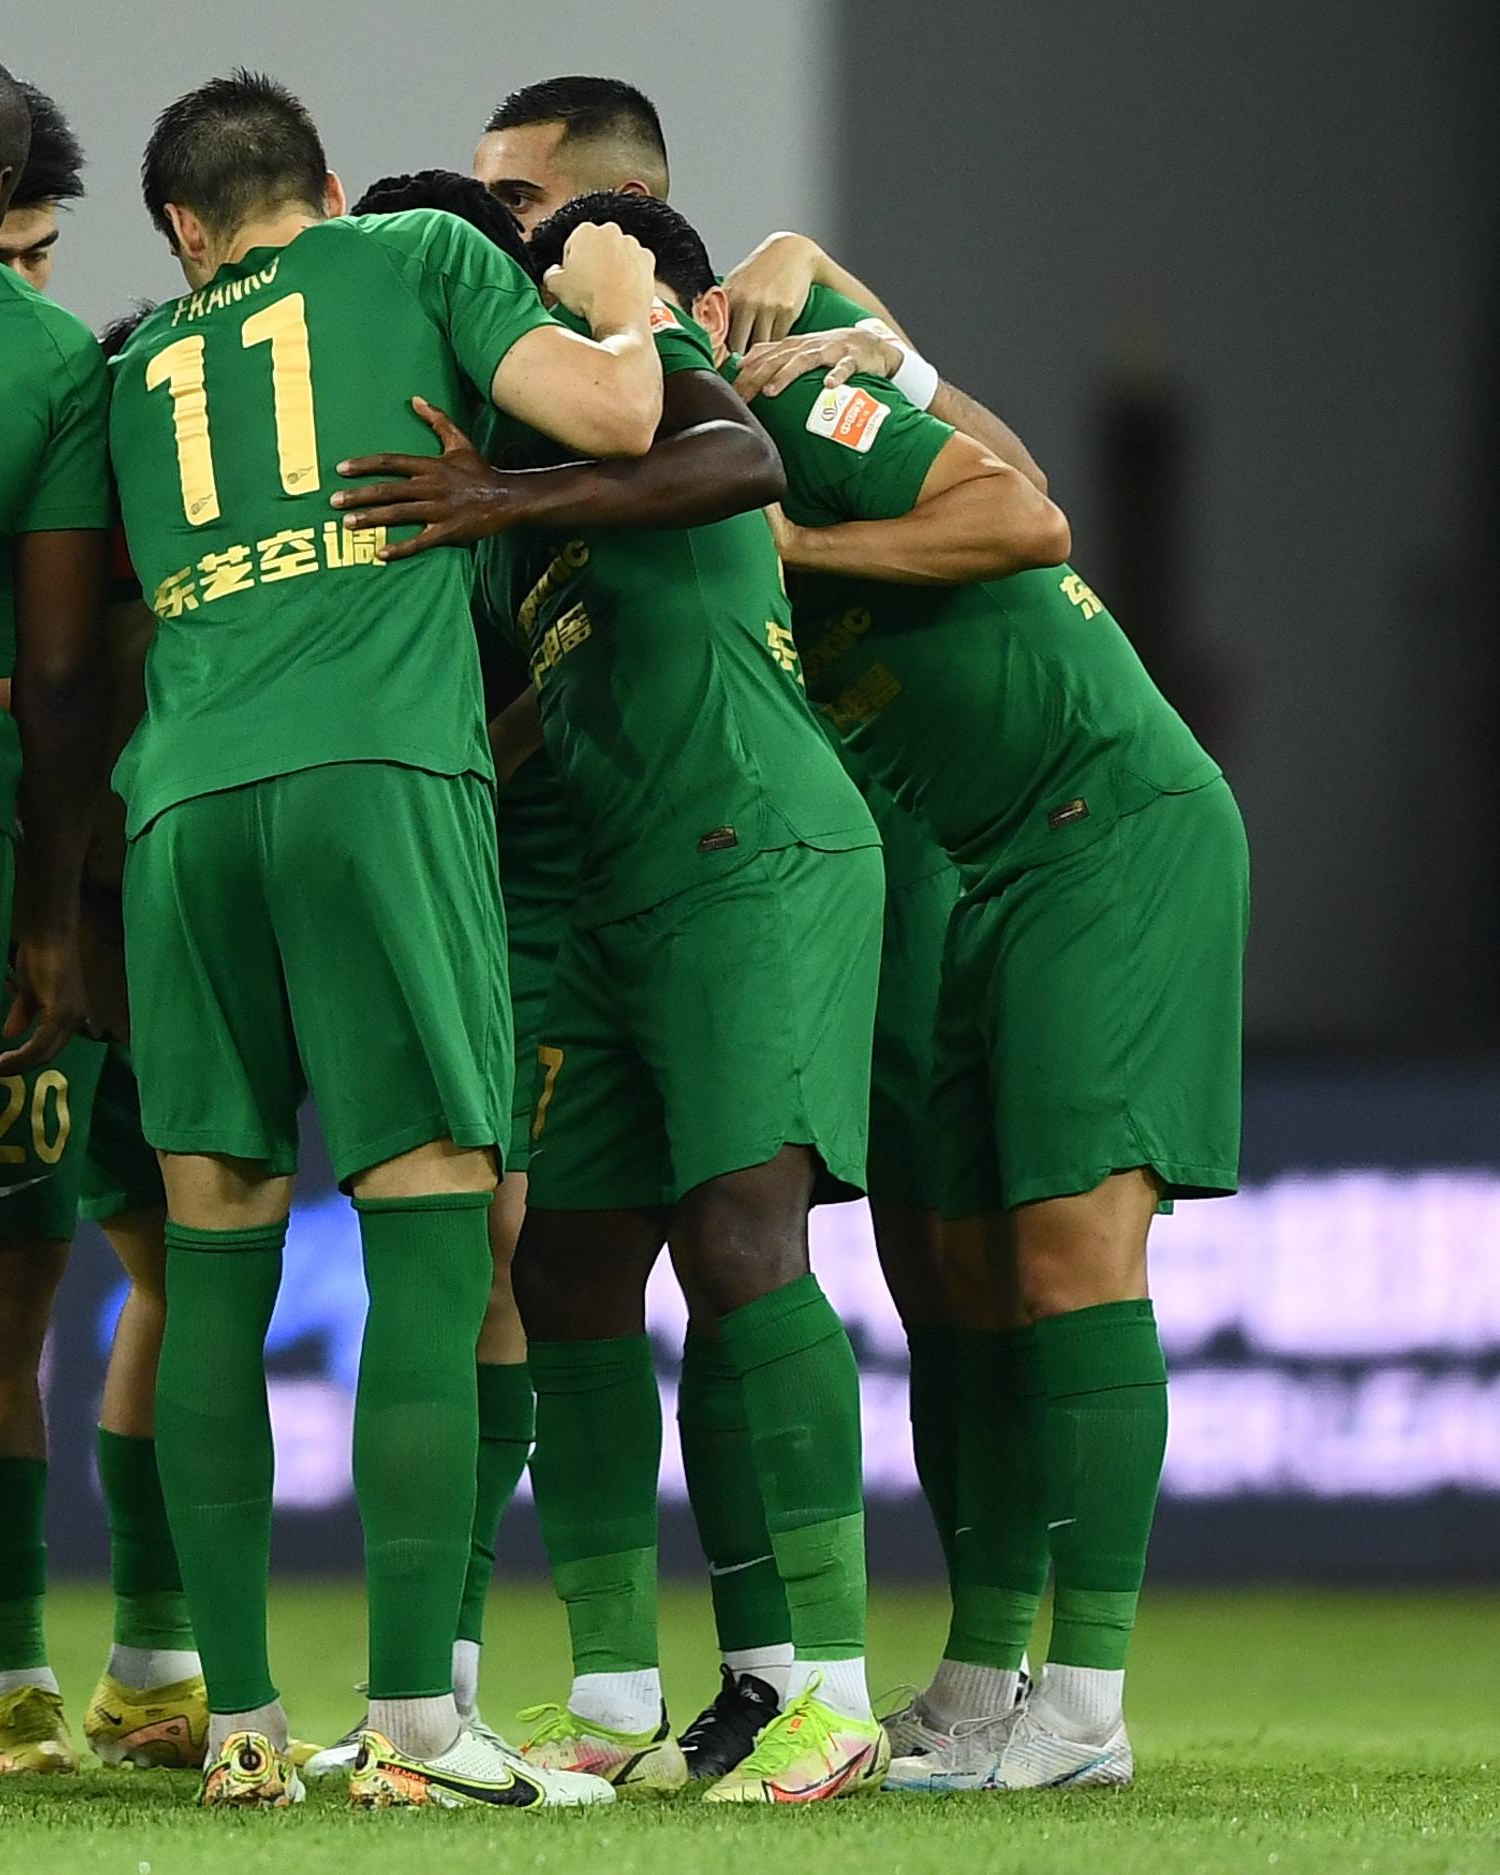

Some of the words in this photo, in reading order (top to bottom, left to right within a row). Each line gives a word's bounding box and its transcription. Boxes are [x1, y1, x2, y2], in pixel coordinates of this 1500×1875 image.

[146, 292, 321, 527] 11
[153, 520, 379, 618] 东芝空调
